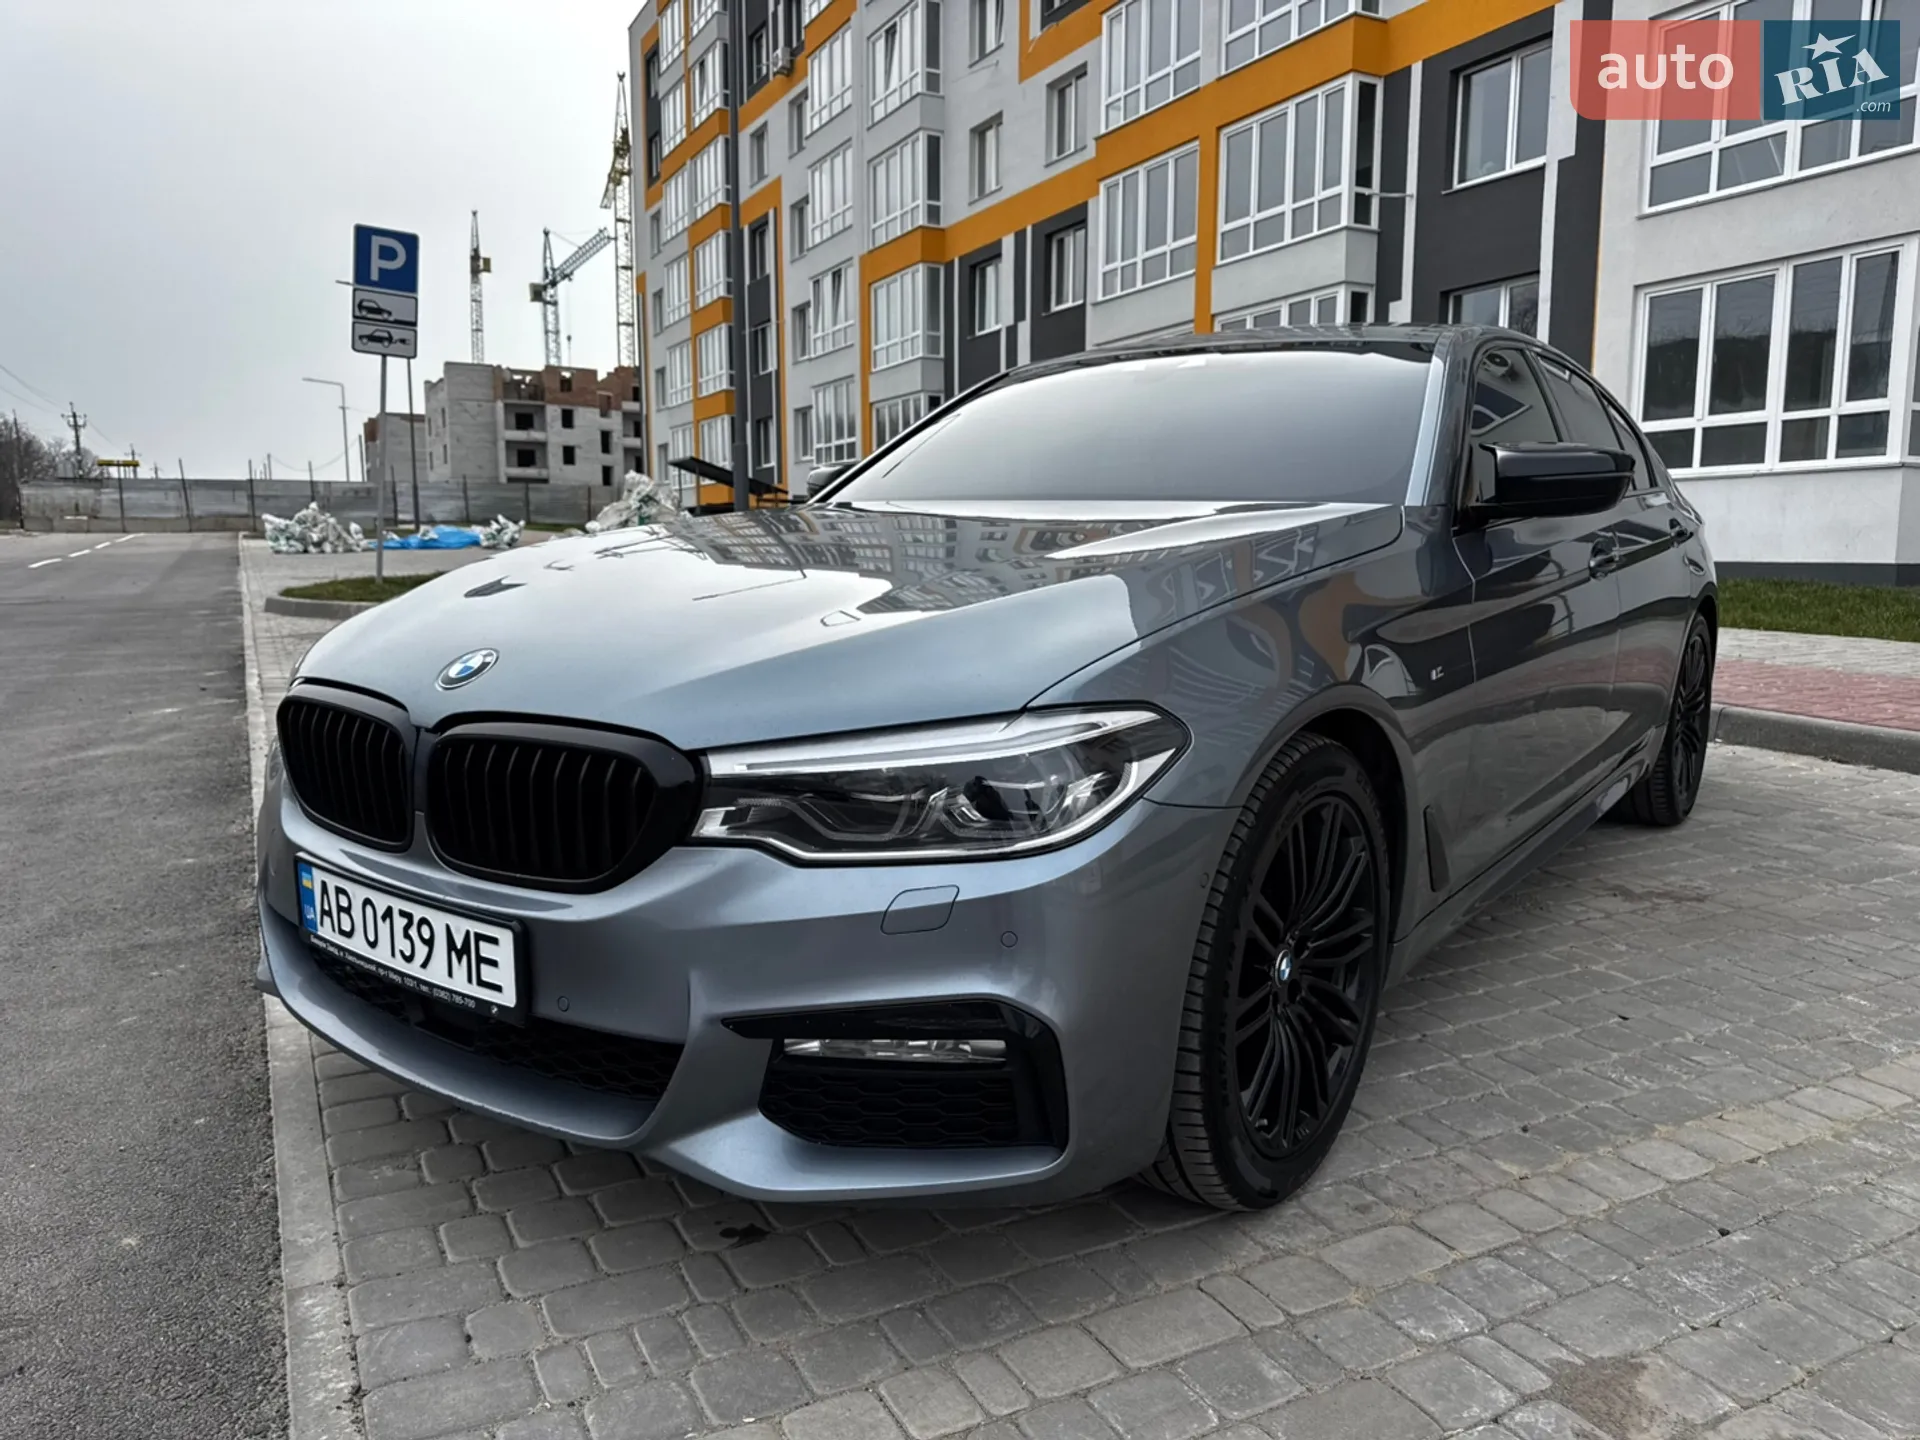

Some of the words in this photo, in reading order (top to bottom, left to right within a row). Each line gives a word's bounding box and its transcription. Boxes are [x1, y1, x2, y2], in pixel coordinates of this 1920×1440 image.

[370, 234, 407, 282] P
[319, 879, 355, 939] AB
[361, 897, 435, 970] 0139
[445, 922, 503, 993] ME
